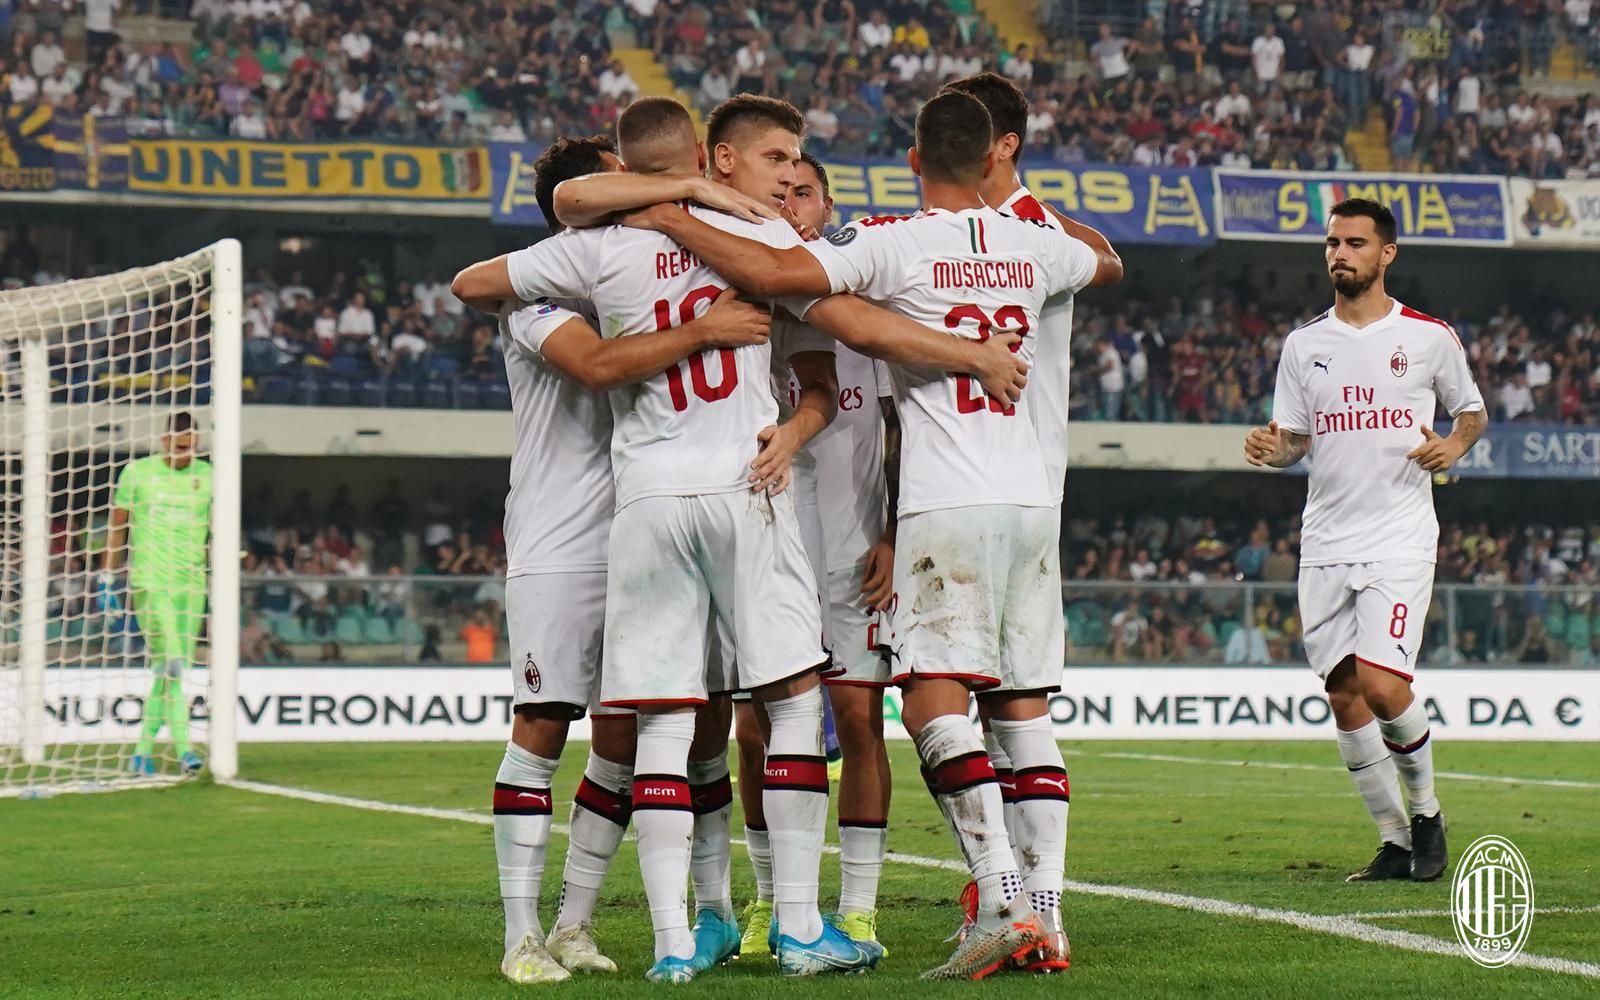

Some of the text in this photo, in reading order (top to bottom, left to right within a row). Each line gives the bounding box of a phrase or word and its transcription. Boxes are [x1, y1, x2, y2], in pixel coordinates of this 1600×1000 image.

[933, 261, 1034, 289] MUSACCHIO
[654, 284, 738, 412] 10
[1342, 385, 1374, 405] Fly
[1315, 405, 1413, 435] Emirates
[1389, 602, 1408, 640] 8
[44, 695, 210, 726] NUOA
[1135, 696, 1330, 726] METANO
[1470, 697, 1533, 726] DA
[644, 786, 676, 797] ACM
